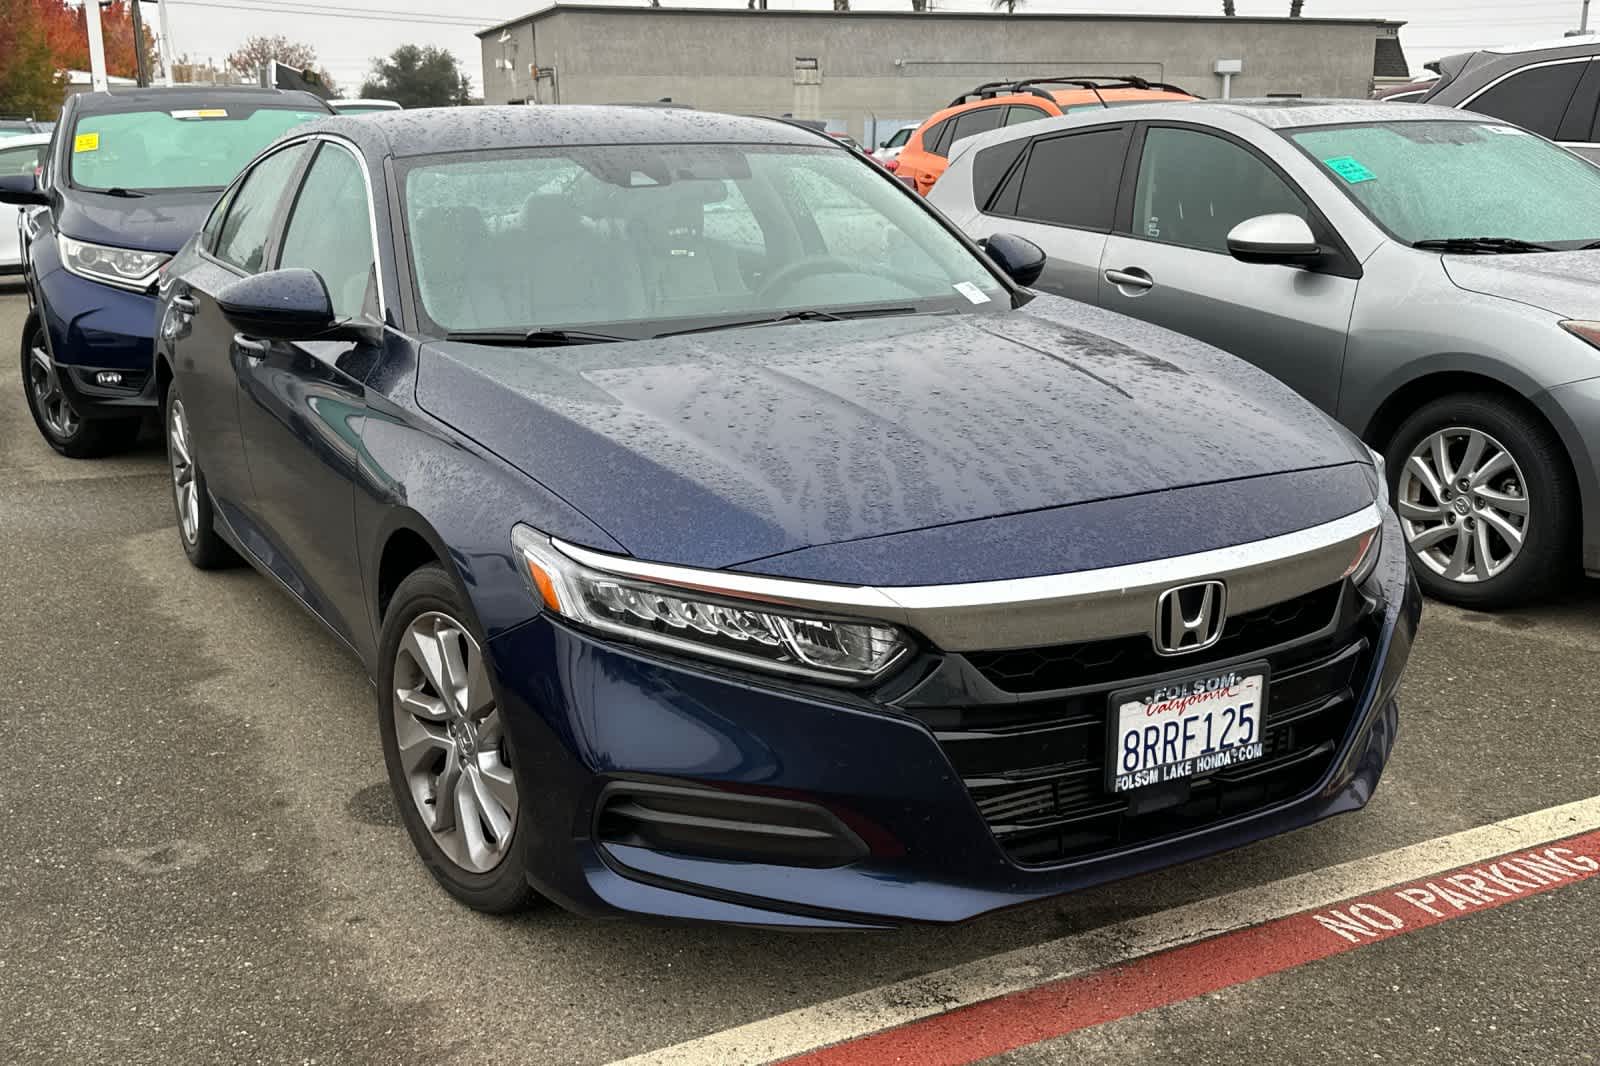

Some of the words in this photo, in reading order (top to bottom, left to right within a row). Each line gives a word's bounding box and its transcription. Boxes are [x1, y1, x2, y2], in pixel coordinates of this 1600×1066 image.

[1146, 687, 1240, 717] California
[1153, 672, 1236, 704] FOLSOM
[1122, 702, 1254, 772] 8RRF125
[1114, 770, 1159, 793] FOLSOM
[1163, 761, 1193, 781] LAKE
[1312, 903, 1404, 943] NO
[1394, 847, 1600, 917] PARKING
